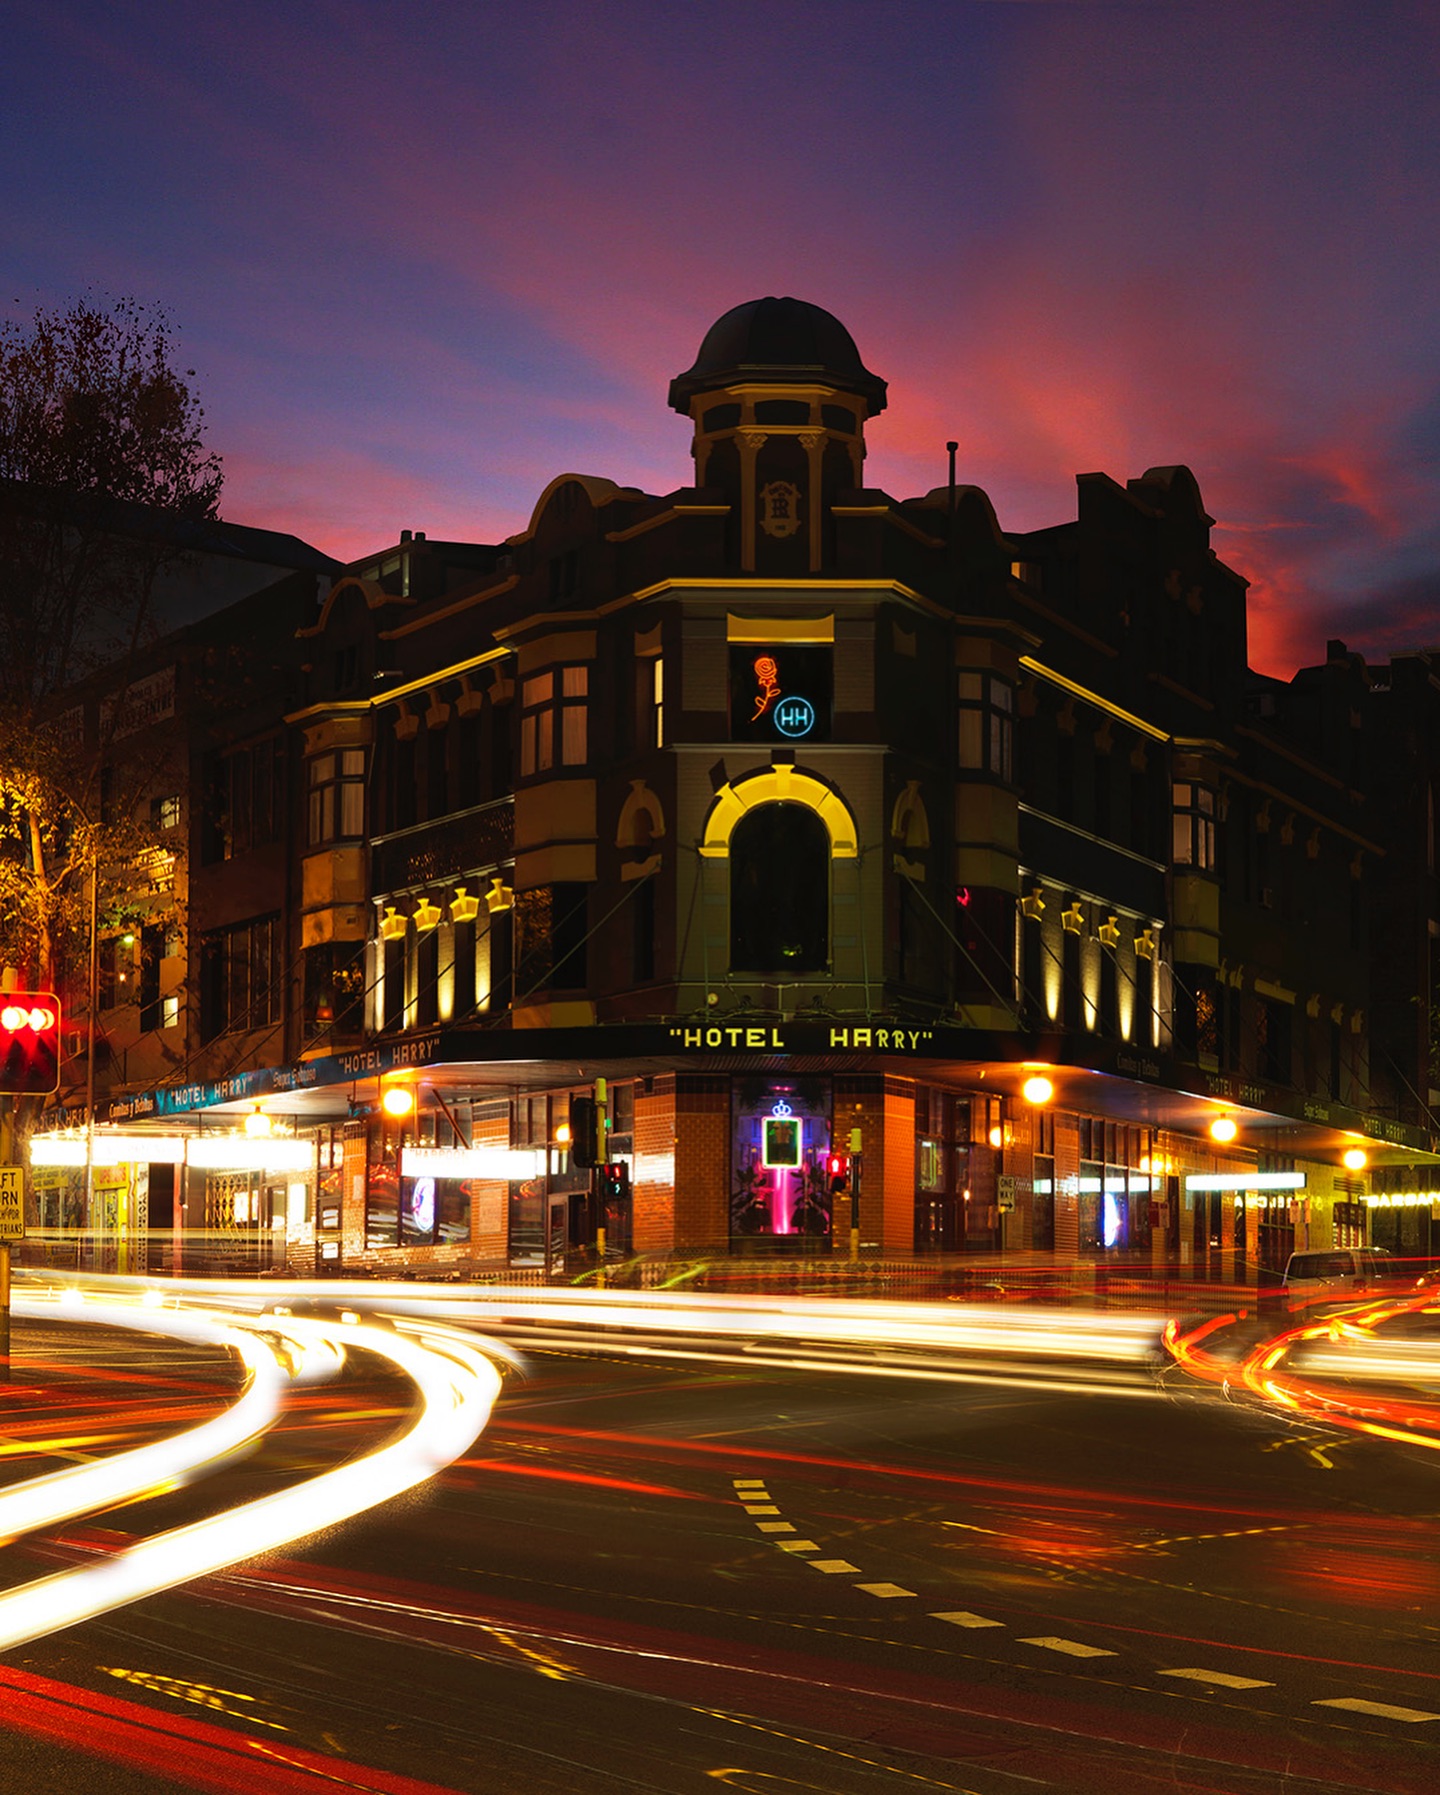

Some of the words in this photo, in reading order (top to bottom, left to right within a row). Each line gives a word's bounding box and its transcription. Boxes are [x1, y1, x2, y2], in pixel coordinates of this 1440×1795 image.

[781, 707, 807, 726] HH
[669, 1028, 785, 1047] "HOTEL
[829, 1028, 932, 1049] HARRY"
[338, 1050, 382, 1074] "HOTEL
[392, 1038, 440, 1065] HARRY"
[170, 1086, 206, 1105] "HOTEL
[213, 1077, 254, 1099] HARRY"
[1000, 1178, 1014, 1188] ONE
[1000, 1191, 1014, 1200] WAY
